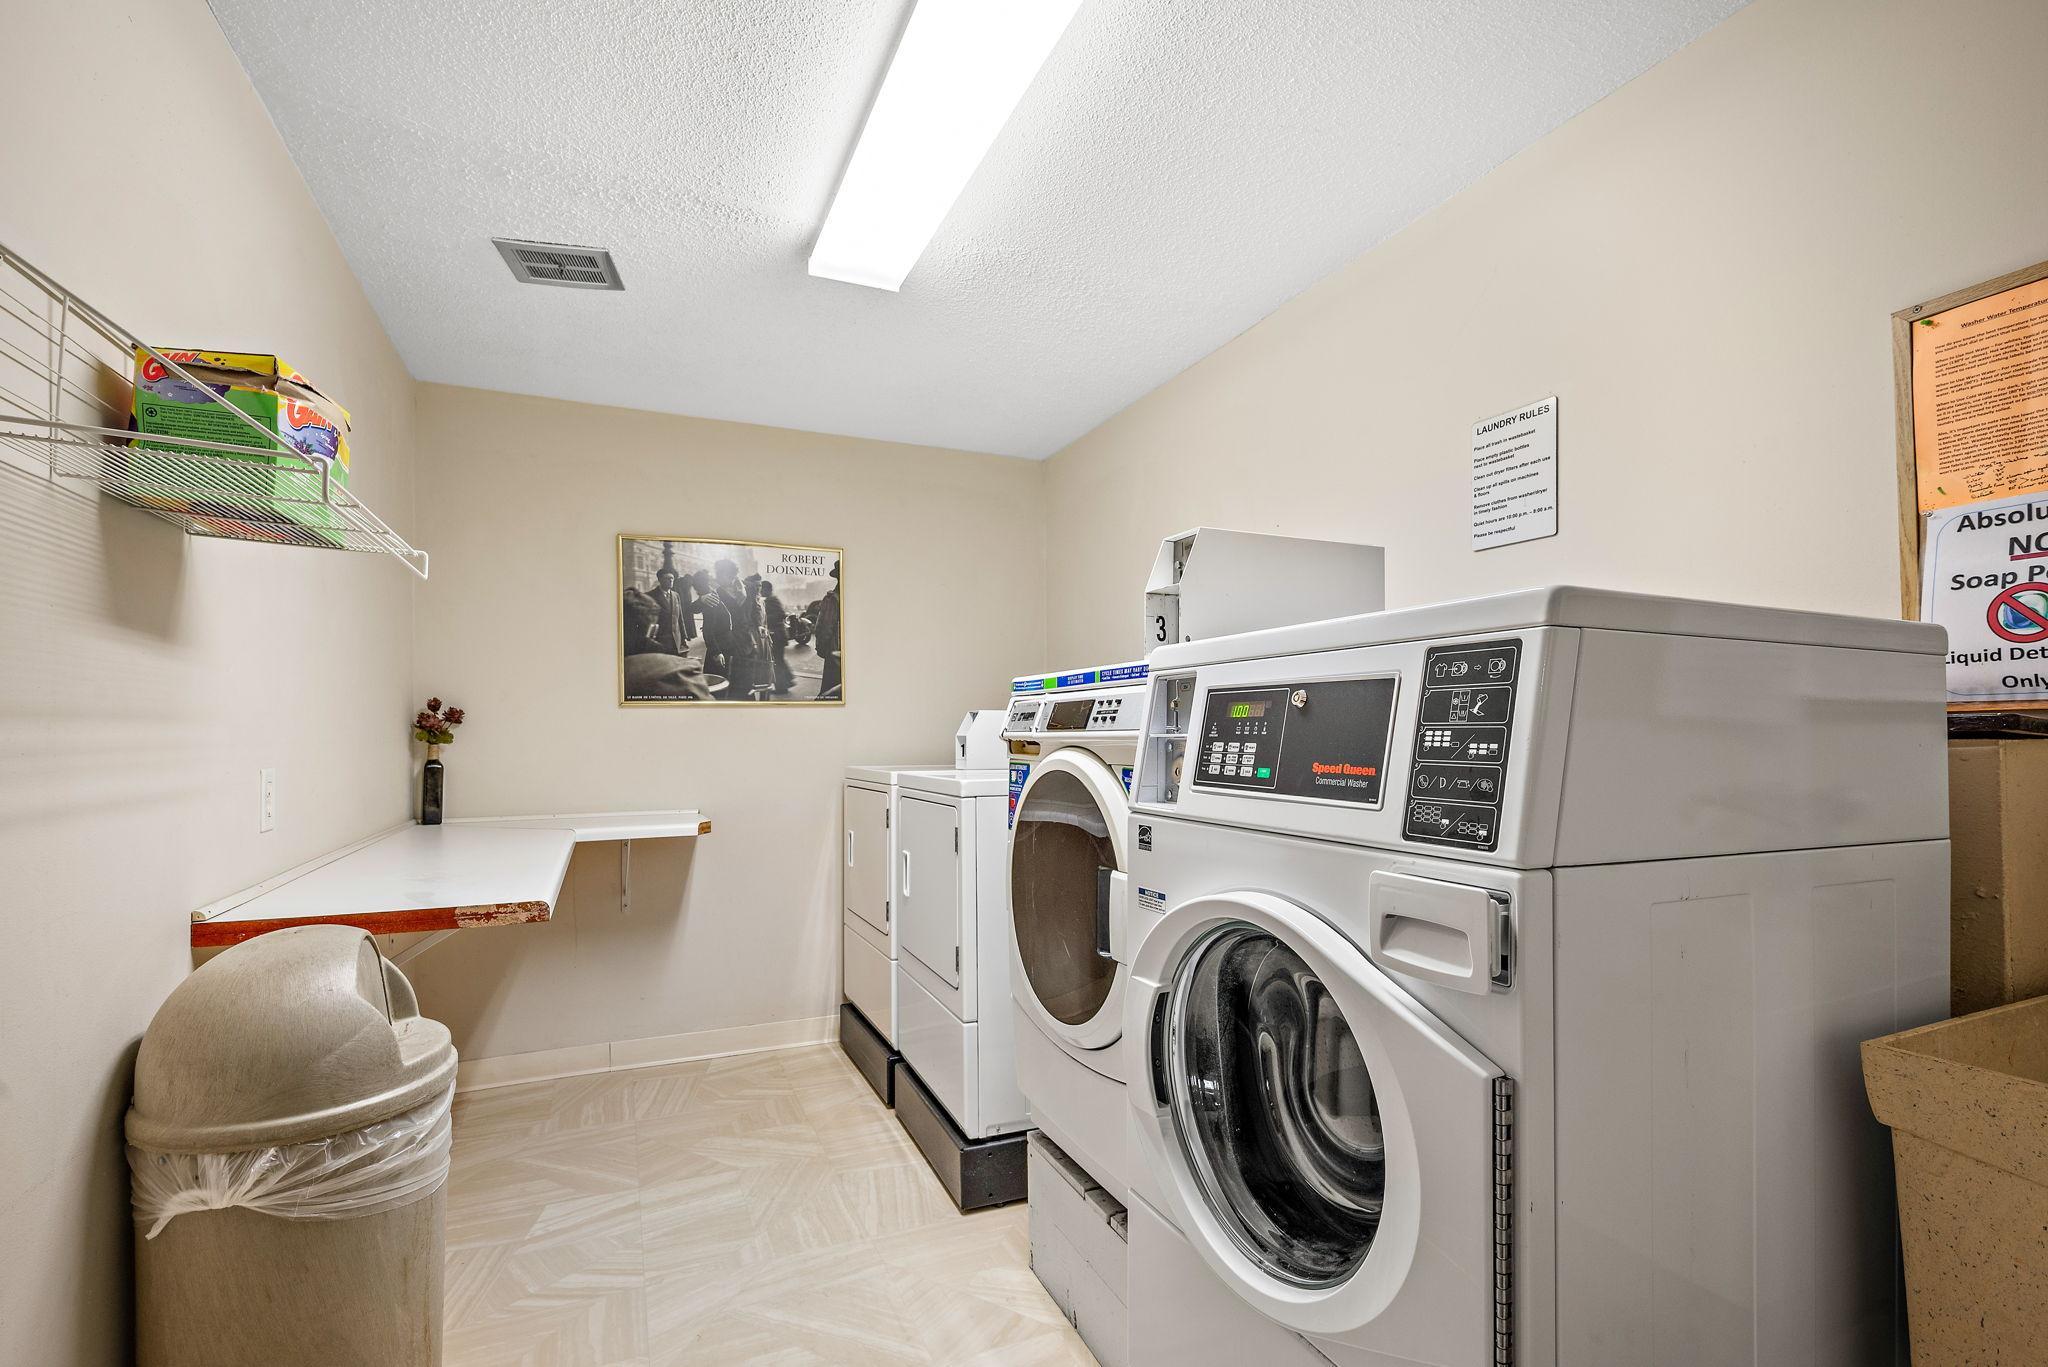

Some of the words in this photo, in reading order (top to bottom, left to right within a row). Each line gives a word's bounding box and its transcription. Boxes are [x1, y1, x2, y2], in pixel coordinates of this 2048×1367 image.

[1961, 317, 1985, 328] Washer
[1987, 310, 2007, 320] Water
[1477, 415, 1517, 436] LAUNDRY
[1520, 404, 1550, 422] RULES
[1957, 503, 2048, 532] Absolu
[781, 554, 826, 565] ROBERT
[766, 565, 825, 577] DOISNEAU
[1950, 570, 2018, 591] Soap
[1155, 615, 1167, 642] 3
[1946, 648, 2001, 667] iquid
[960, 743, 965, 757] 1
[1312, 762, 1343, 775] Speed
[1343, 764, 1377, 776] Queen
[1315, 776, 1346, 786] Commercial
[1347, 778, 1368, 788] Washer
